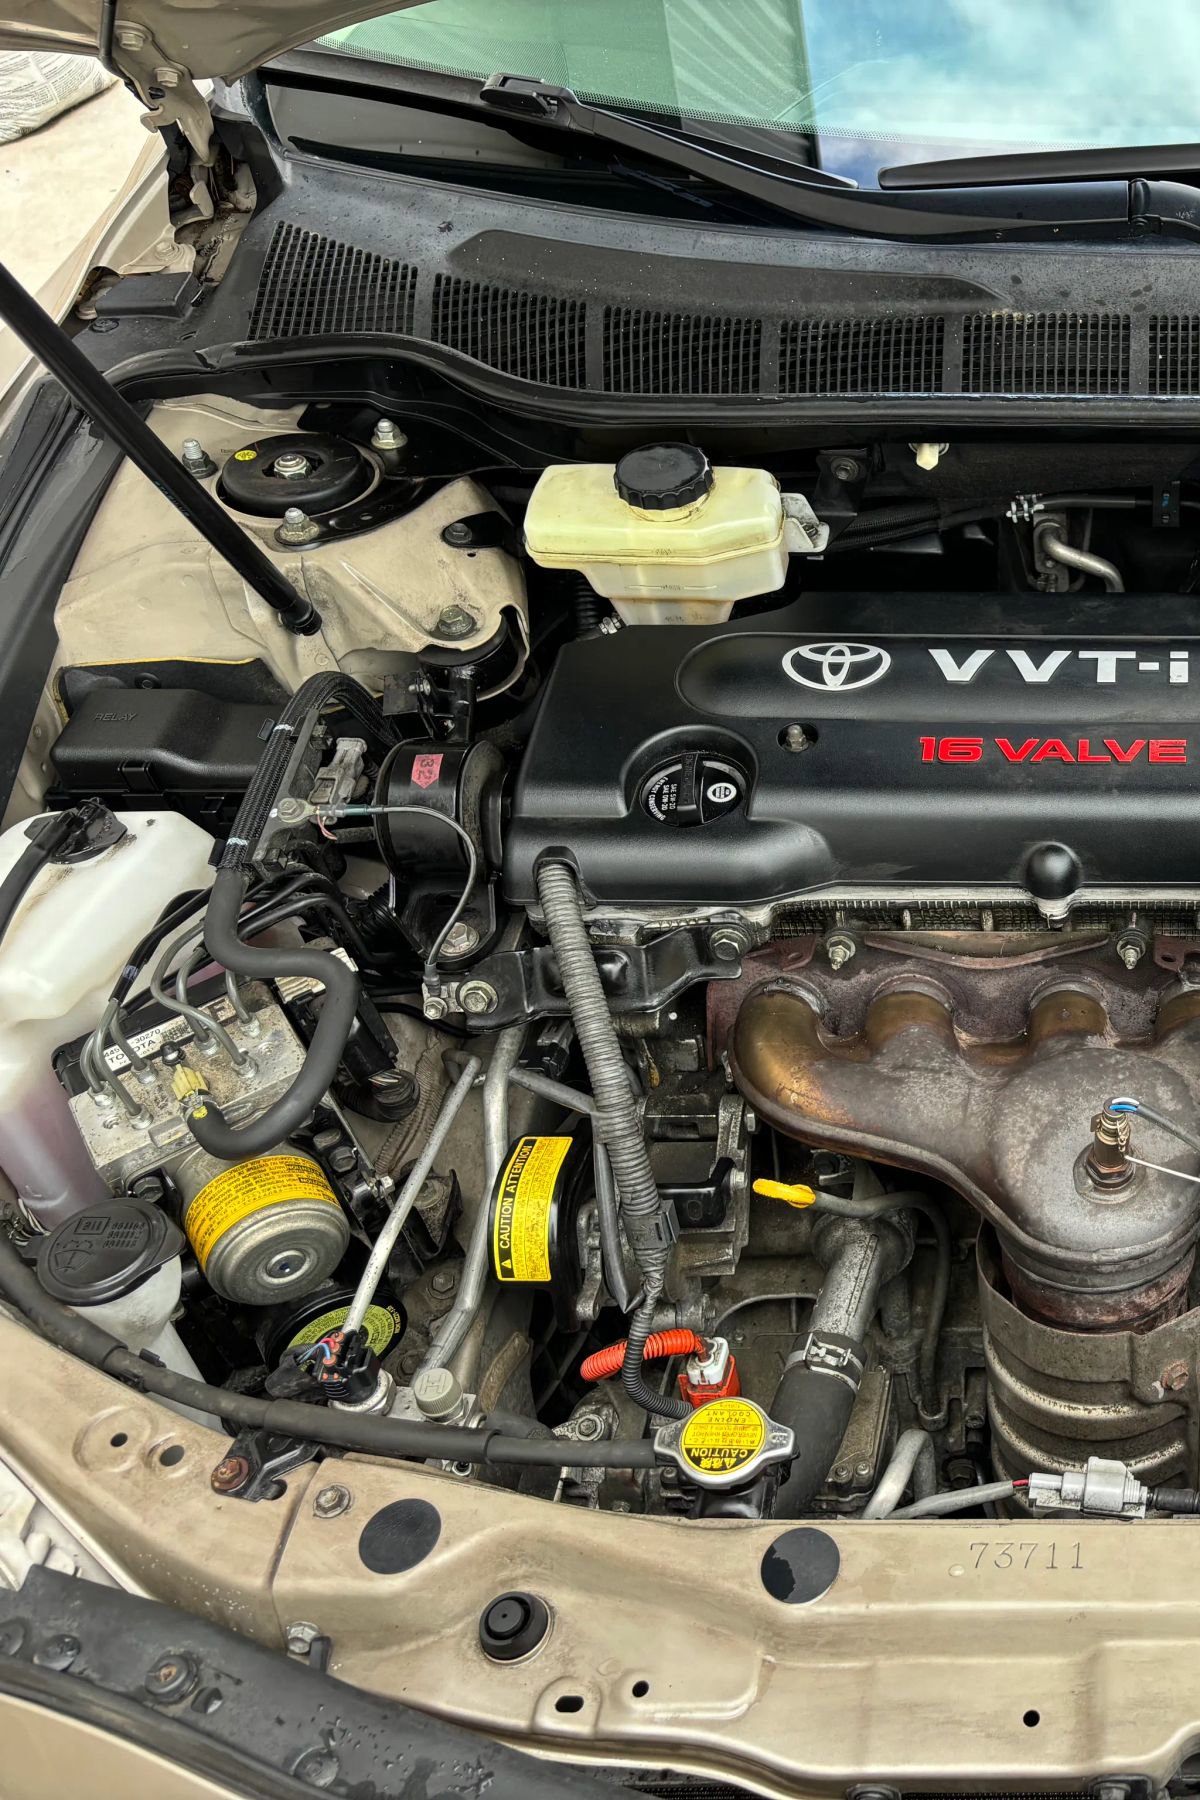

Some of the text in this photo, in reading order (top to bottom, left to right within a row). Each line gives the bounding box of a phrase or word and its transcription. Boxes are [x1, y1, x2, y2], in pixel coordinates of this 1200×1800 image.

[928, 649, 1189, 684] VVT-i
[919, 737, 1188, 764] 16 VALVE
[506, 1145, 533, 1194] ATTENTION
[500, 1198, 514, 1249] CAUTION
[690, 1448, 748, 1458] CAUTION
[970, 1542, 1084, 1569] 73711
